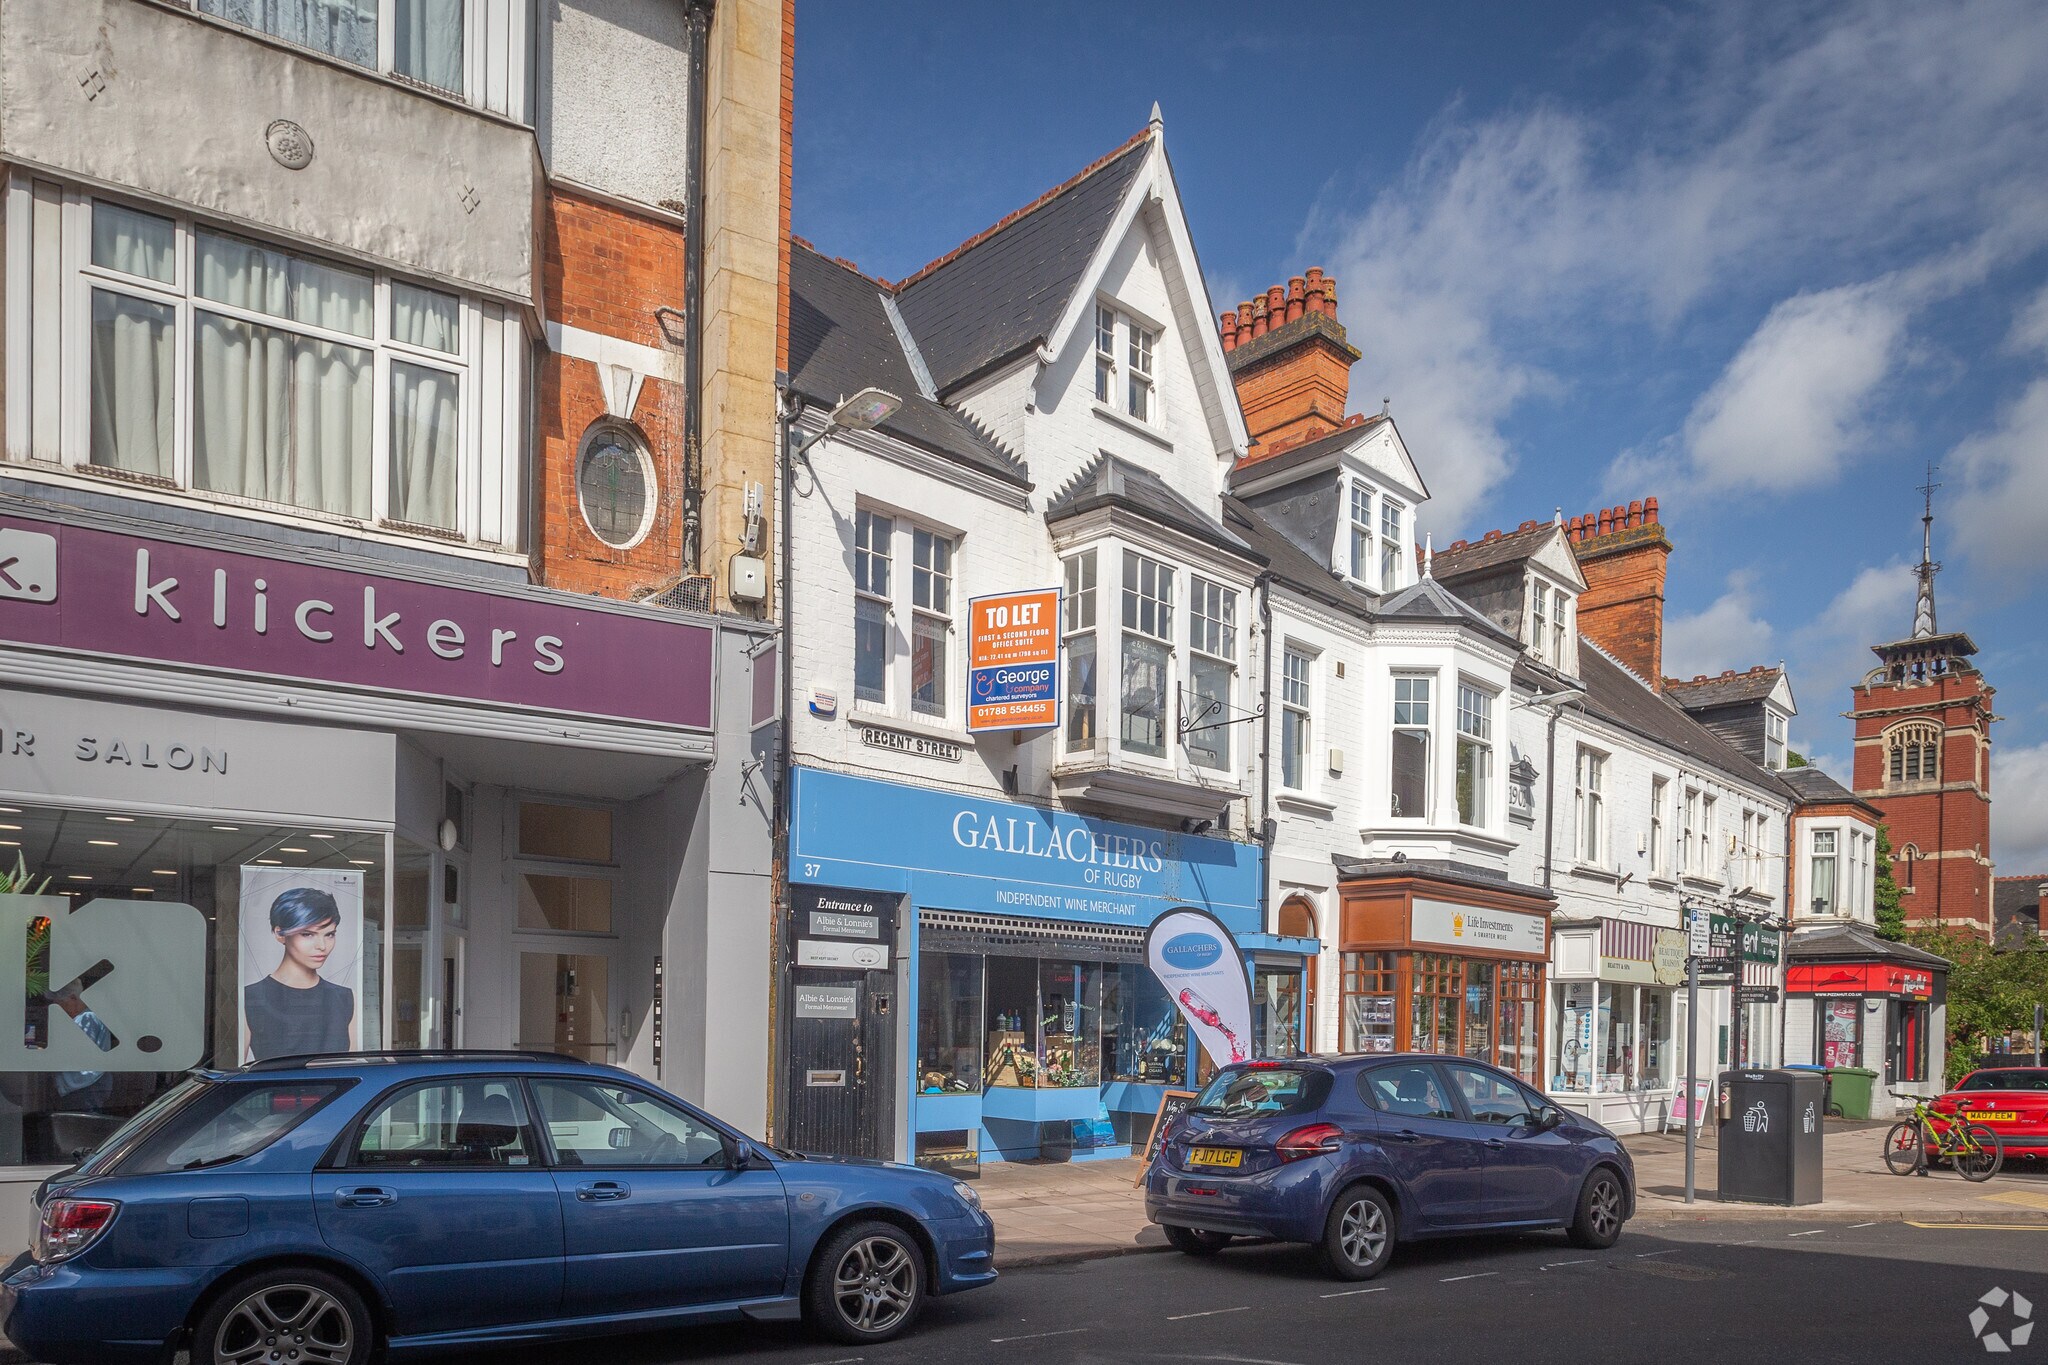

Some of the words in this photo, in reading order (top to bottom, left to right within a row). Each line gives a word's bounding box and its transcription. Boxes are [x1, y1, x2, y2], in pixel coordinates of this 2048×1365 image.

[135, 548, 564, 674] klickers
[986, 606, 1008, 629] TO
[1013, 603, 1041, 626] LET
[979, 633, 995, 642] FIRST
[1003, 630, 1028, 639] SECOND
[1030, 629, 1049, 637] FLOOR
[992, 640, 1013, 649] OFFICE
[1015, 638, 1033, 647] SUITE
[996, 669, 1050, 684] George
[1014, 683, 1049, 693] company
[978, 706, 1007, 716] 01788
[1010, 704, 1046, 714] 554455
[75, 734, 228, 775] SALON
[917, 739, 959, 759] STREET
[953, 810, 1162, 873] GALLACHERS
[805, 863, 821, 878] 37
[1084, 868, 1101, 884] OF
[1104, 872, 1142, 889] RUGBY
[817, 897, 862, 913] Entrance
[863, 902, 873, 913] to
[996, 891, 1062, 909] INDEPENDENT
[1065, 898, 1088, 912] WINE
[1090, 901, 1136, 916] MERCHANT
[817, 916, 836, 926] Albie
[837, 918, 843, 926] &
[845, 918, 873, 929] Lonnie's
[1468, 916, 1480, 928] Life
[1480, 917, 1514, 933] Investments
[841, 927, 867, 935] Menswear
[1478, 932, 1496, 940] SMARTER
[1167, 944, 1217, 954] GALLACHERS
[1659, 947, 1684, 960] BEAUTIQUE
[1608, 962, 1621, 970] BEAUTY
[1662, 959, 1680, 968] MAISON
[799, 994, 818, 1002] Albie
[826, 995, 854, 1004] Lonnie's
[1193, 1149, 1215, 1161] FJ17
[1216, 1150, 1238, 1164] LGF
